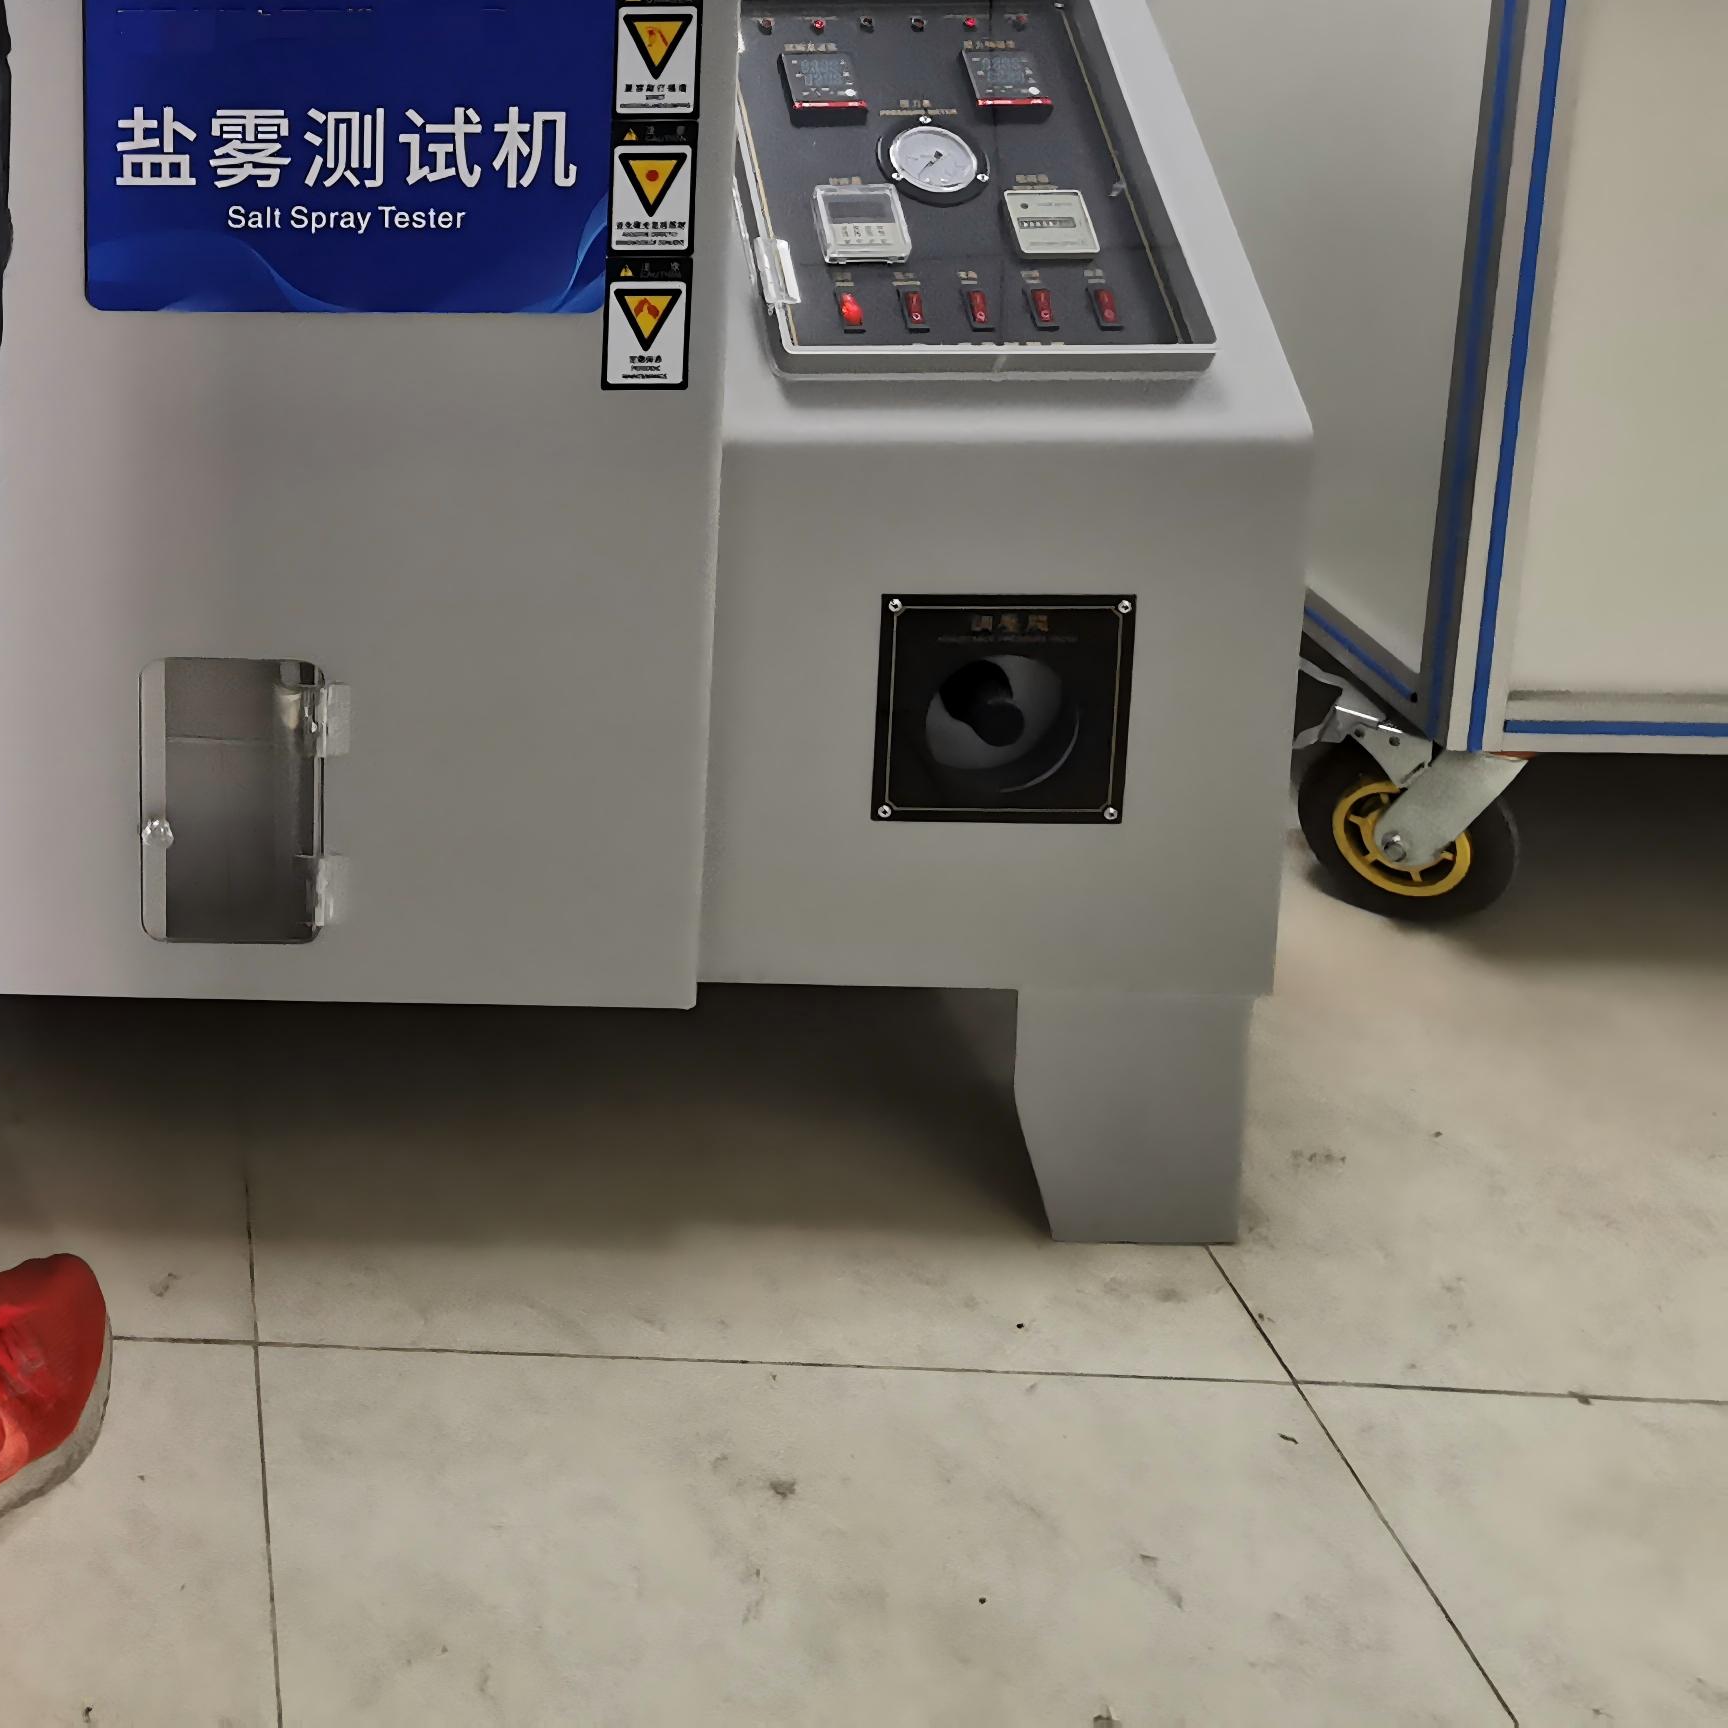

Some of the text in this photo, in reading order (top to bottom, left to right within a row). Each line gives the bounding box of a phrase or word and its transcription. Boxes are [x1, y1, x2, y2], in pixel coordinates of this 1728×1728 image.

[115, 105, 578, 190] 盐雾测试机
[227, 205, 467, 235] Salt Spray Tester
